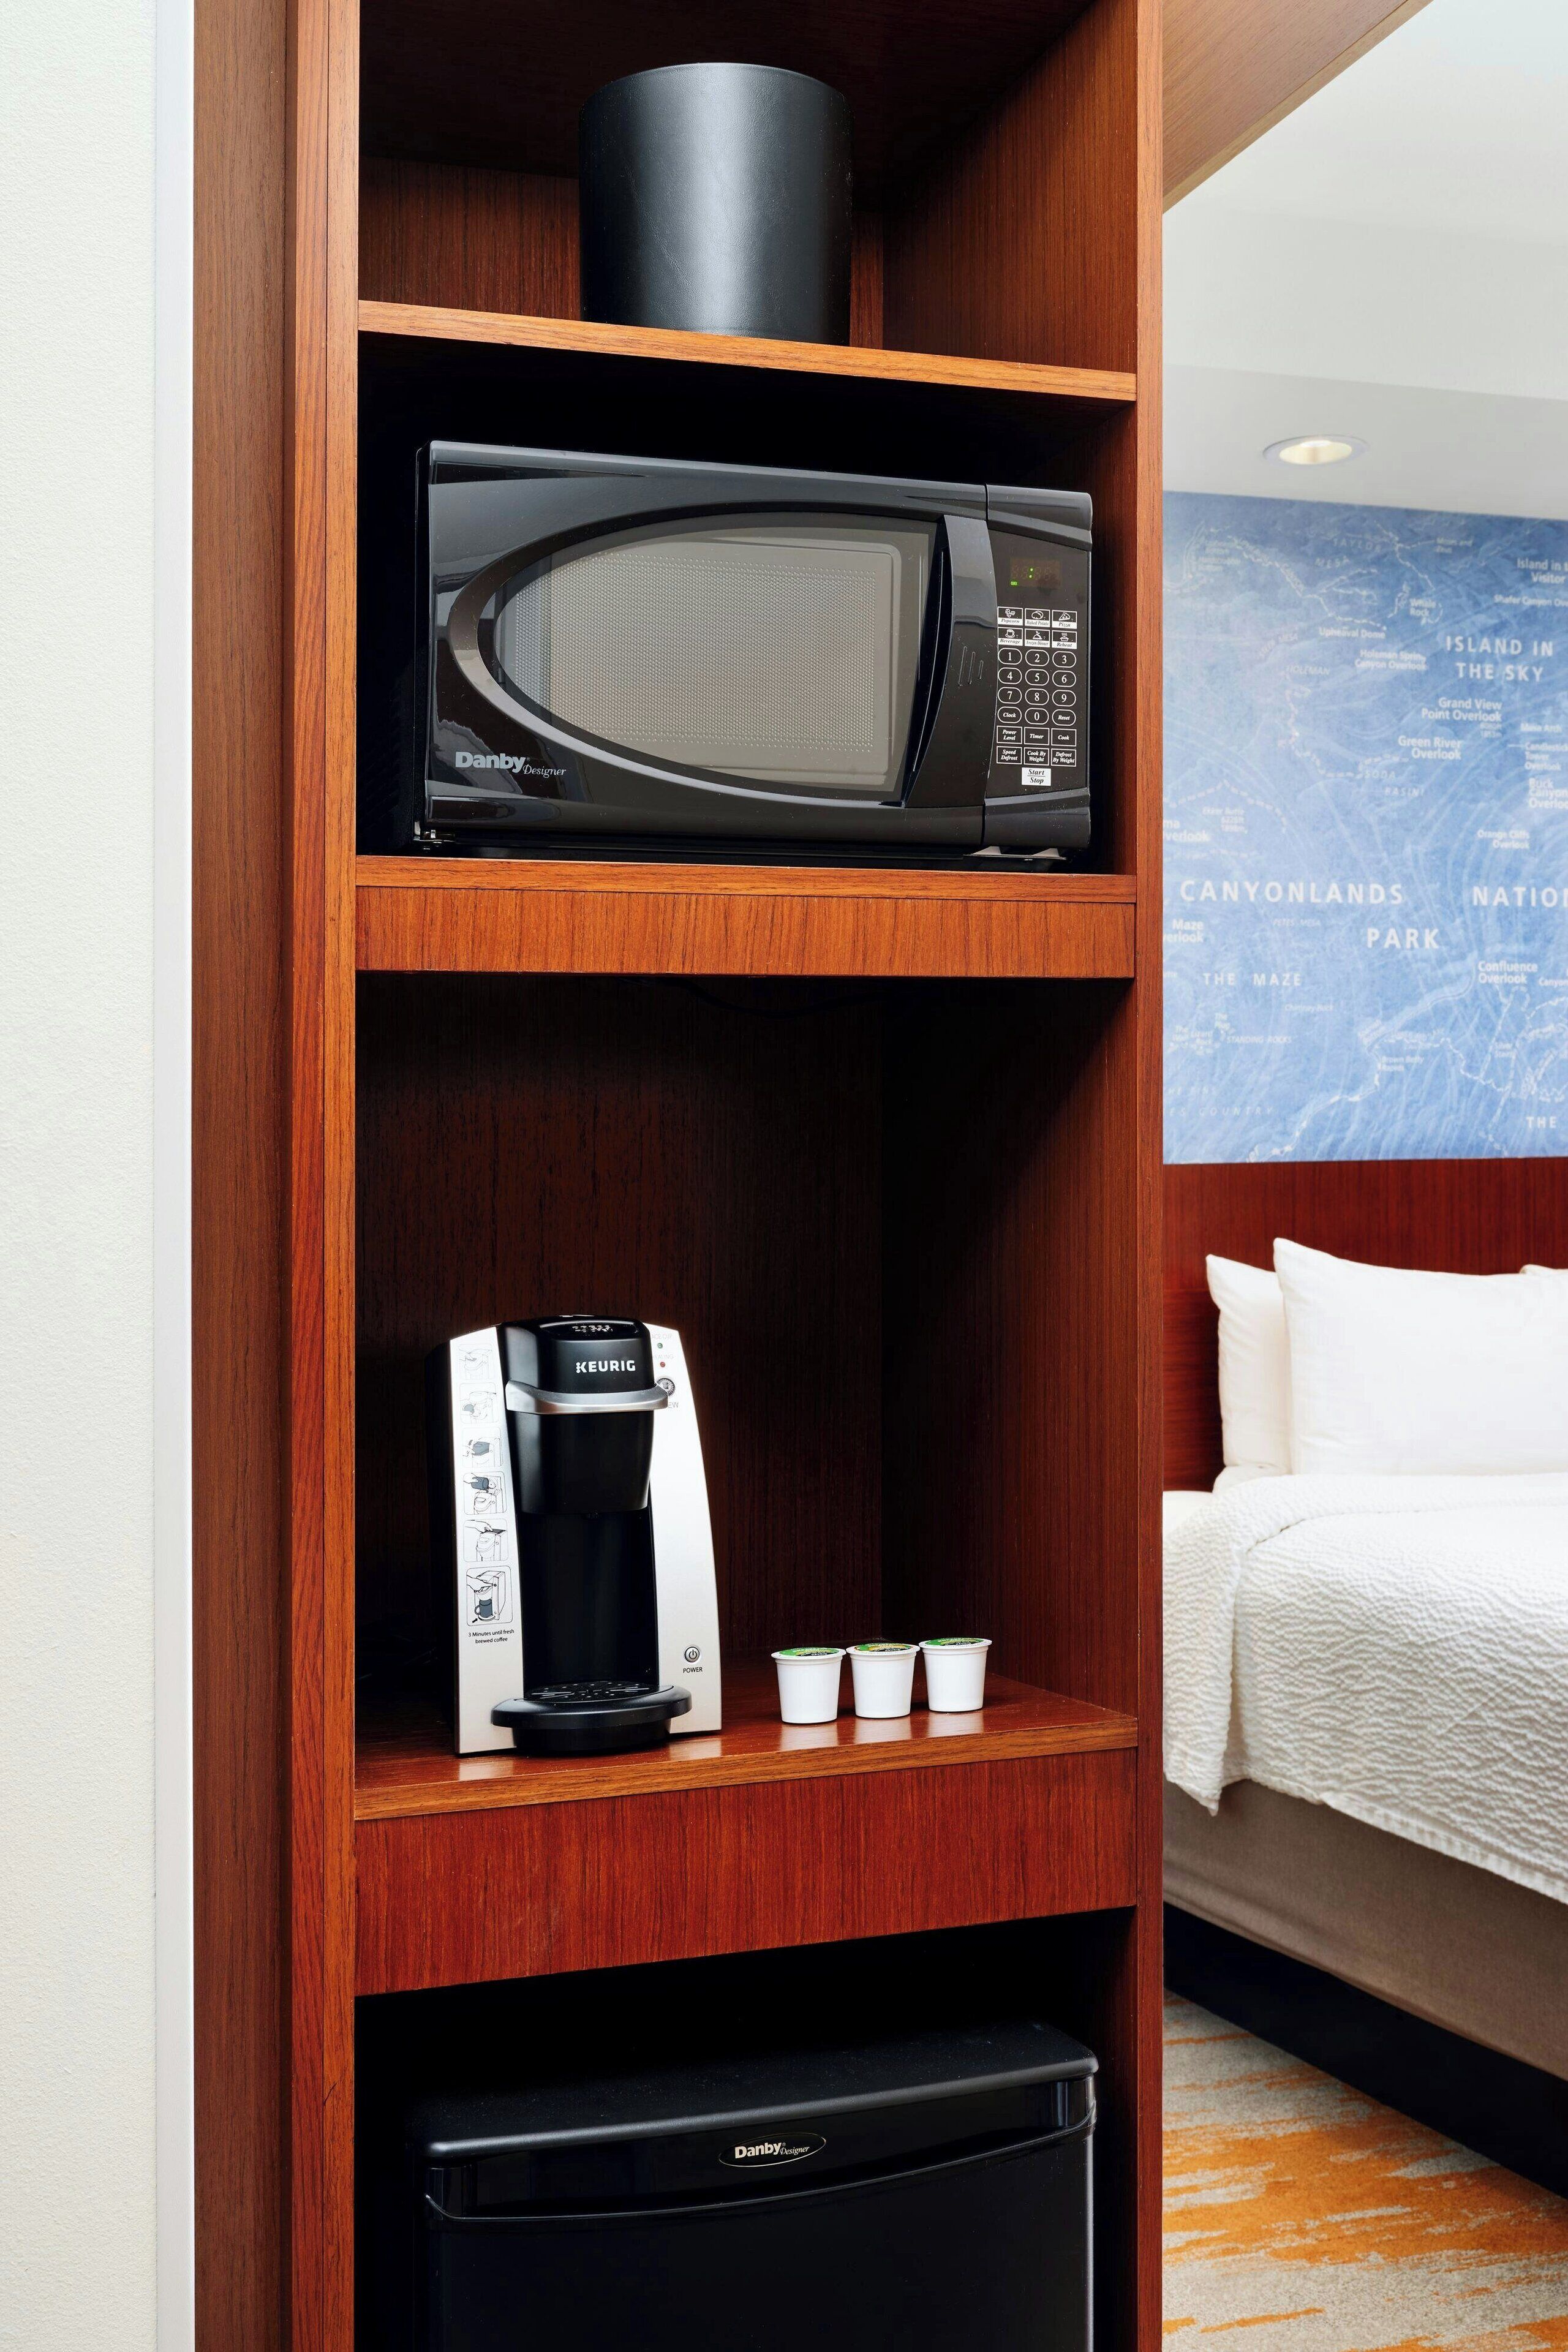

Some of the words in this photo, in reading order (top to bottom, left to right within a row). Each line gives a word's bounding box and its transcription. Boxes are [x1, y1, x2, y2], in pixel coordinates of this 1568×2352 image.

[1517, 558, 1548, 570] Island
[1551, 559, 1561, 571] in
[1531, 571, 1566, 584] Visitor
[1494, 594, 1520, 604] Shafer
[1522, 596, 1552, 607] Canyon
[1410, 607, 1429, 617] Rock
[1361, 628, 1385, 639] Dome
[1446, 635, 1523, 655] ISLAND
[1532, 639, 1554, 657] IN
[1008, 652, 1012, 661] 1
[1035, 654, 1040, 662] 2
[1061, 655, 1067, 664] 3
[1354, 659, 1387, 670] Canyon
[1389, 660, 1427, 671] Overlook
[1007, 671, 1013, 680] 4
[1035, 673, 1040, 682] 5
[1456, 662, 1494, 680] THE
[1505, 663, 1544, 682] SKY
[1061, 674, 1067, 684] 6
[1007, 691, 1012, 699] 7
[1035, 692, 1040, 701] 8
[1061, 694, 1067, 703] 9
[1438, 696, 1472, 709] Grand
[1474, 698, 1503, 710] View
[1034, 712, 1040, 721] 0
[1421, 707, 1450, 720] Point
[1452, 709, 1502, 722] Overlook
[1398, 735, 1431, 747] Green
[1433, 736, 1463, 748] River
[1411, 747, 1461, 760] Overlook
[455, 752, 526, 773] Danby
[522, 763, 567, 778] Designer
[1529, 797, 1568, 809] Overloo
[1163, 829, 1211, 842] verlook
[1477, 829, 1507, 840] Orange
[1180, 880, 1404, 905] CANYONLANDS
[1172, 919, 1204, 930] Maze
[1366, 927, 1439, 949] PARK
[1478, 960, 1538, 973] Confluence
[1203, 971, 1237, 986] THE
[1253, 973, 1303, 987] MAZE
[1479, 972, 1528, 984] Overlook
[1227, 1035, 1264, 1044] STANDING
[1526, 1116, 1557, 1129] THE
[575, 1360, 636, 1374] KEURIG
[734, 2142, 782, 2158] Danby
[780, 2146, 810, 2155] Designer
